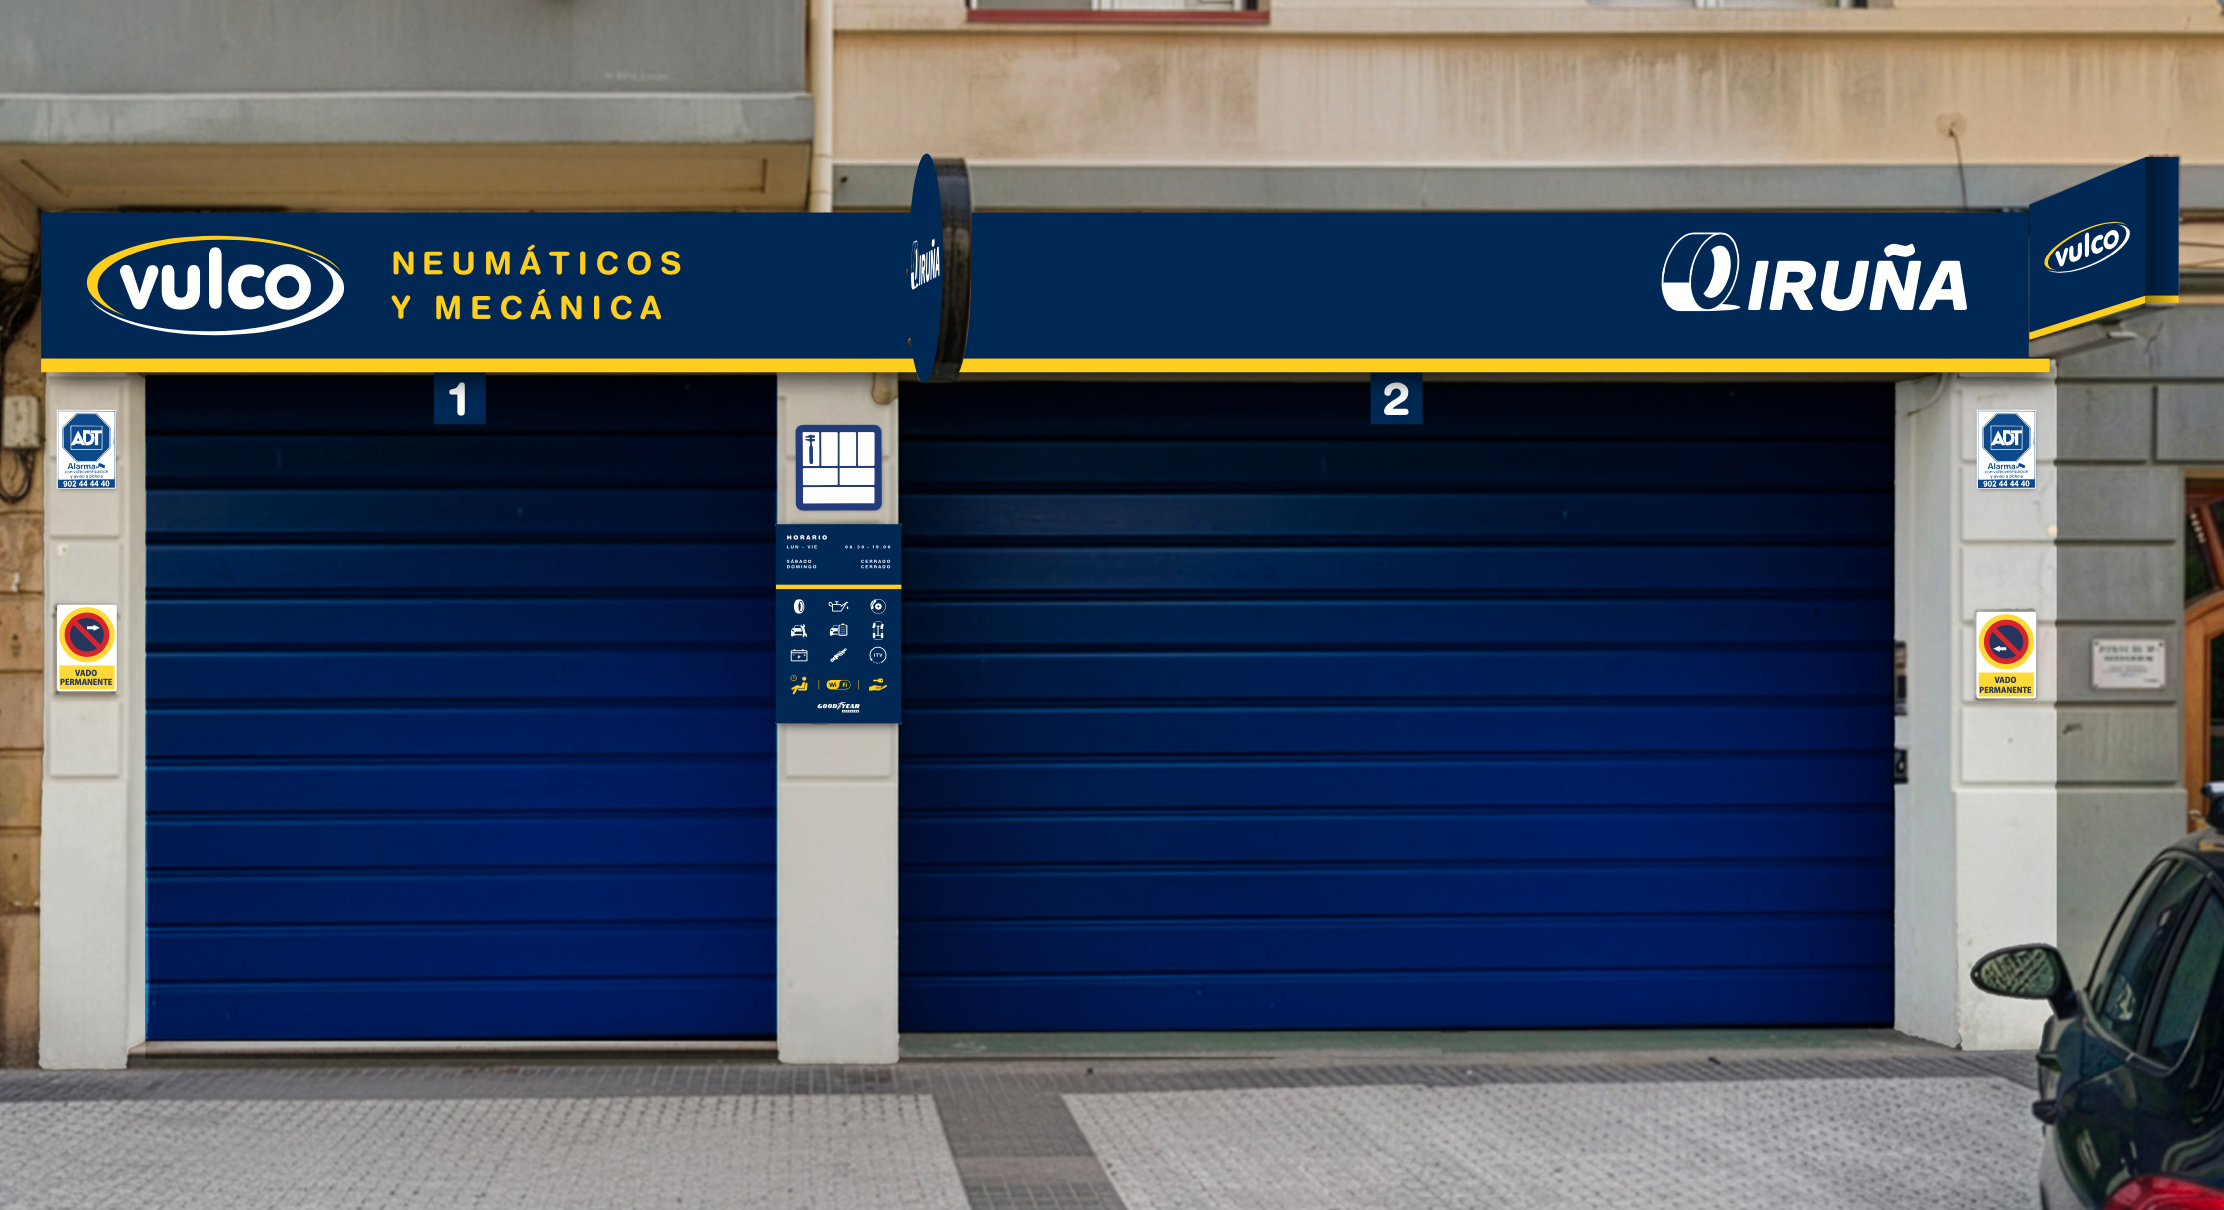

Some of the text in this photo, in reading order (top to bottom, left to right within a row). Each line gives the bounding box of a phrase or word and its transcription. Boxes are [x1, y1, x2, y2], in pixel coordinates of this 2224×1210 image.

[392, 244, 682, 276] NEUMÁTICOS
[2055, 230, 2119, 267] vulco
[119, 247, 312, 311] vulco
[1748, 243, 1967, 312] IRUÑA
[391, 289, 662, 321] Y MECÁNICA
[448, 382, 466, 417] 1
[1384, 382, 1409, 416] 2
[71, 430, 102, 446] ADT
[1991, 430, 2022, 446] ADT
[63, 480, 77, 488] 902
[1983, 480, 1997, 488] 902
[60, 678, 112, 686] PERMANENTE
[1979, 686, 2031, 694] PERMANENTE
